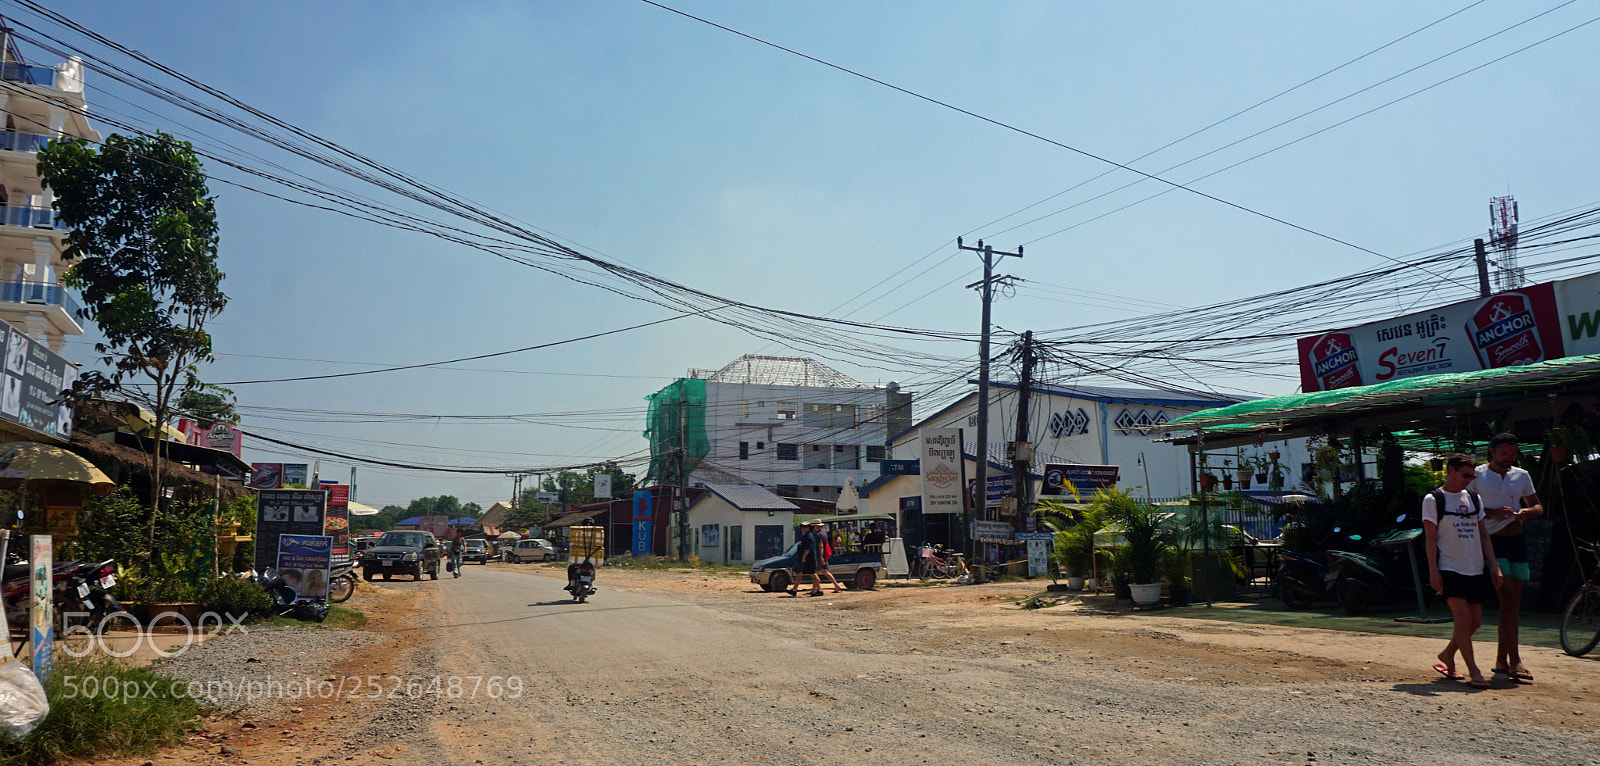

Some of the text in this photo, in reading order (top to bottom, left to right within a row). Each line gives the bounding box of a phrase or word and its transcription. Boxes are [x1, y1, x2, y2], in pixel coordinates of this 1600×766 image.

[1479, 314, 1532, 346] ANCHOR
[1495, 334, 1529, 357] Smooth
[1317, 350, 1357, 375] ANCHOR
[638, 521, 647, 552] KUB
